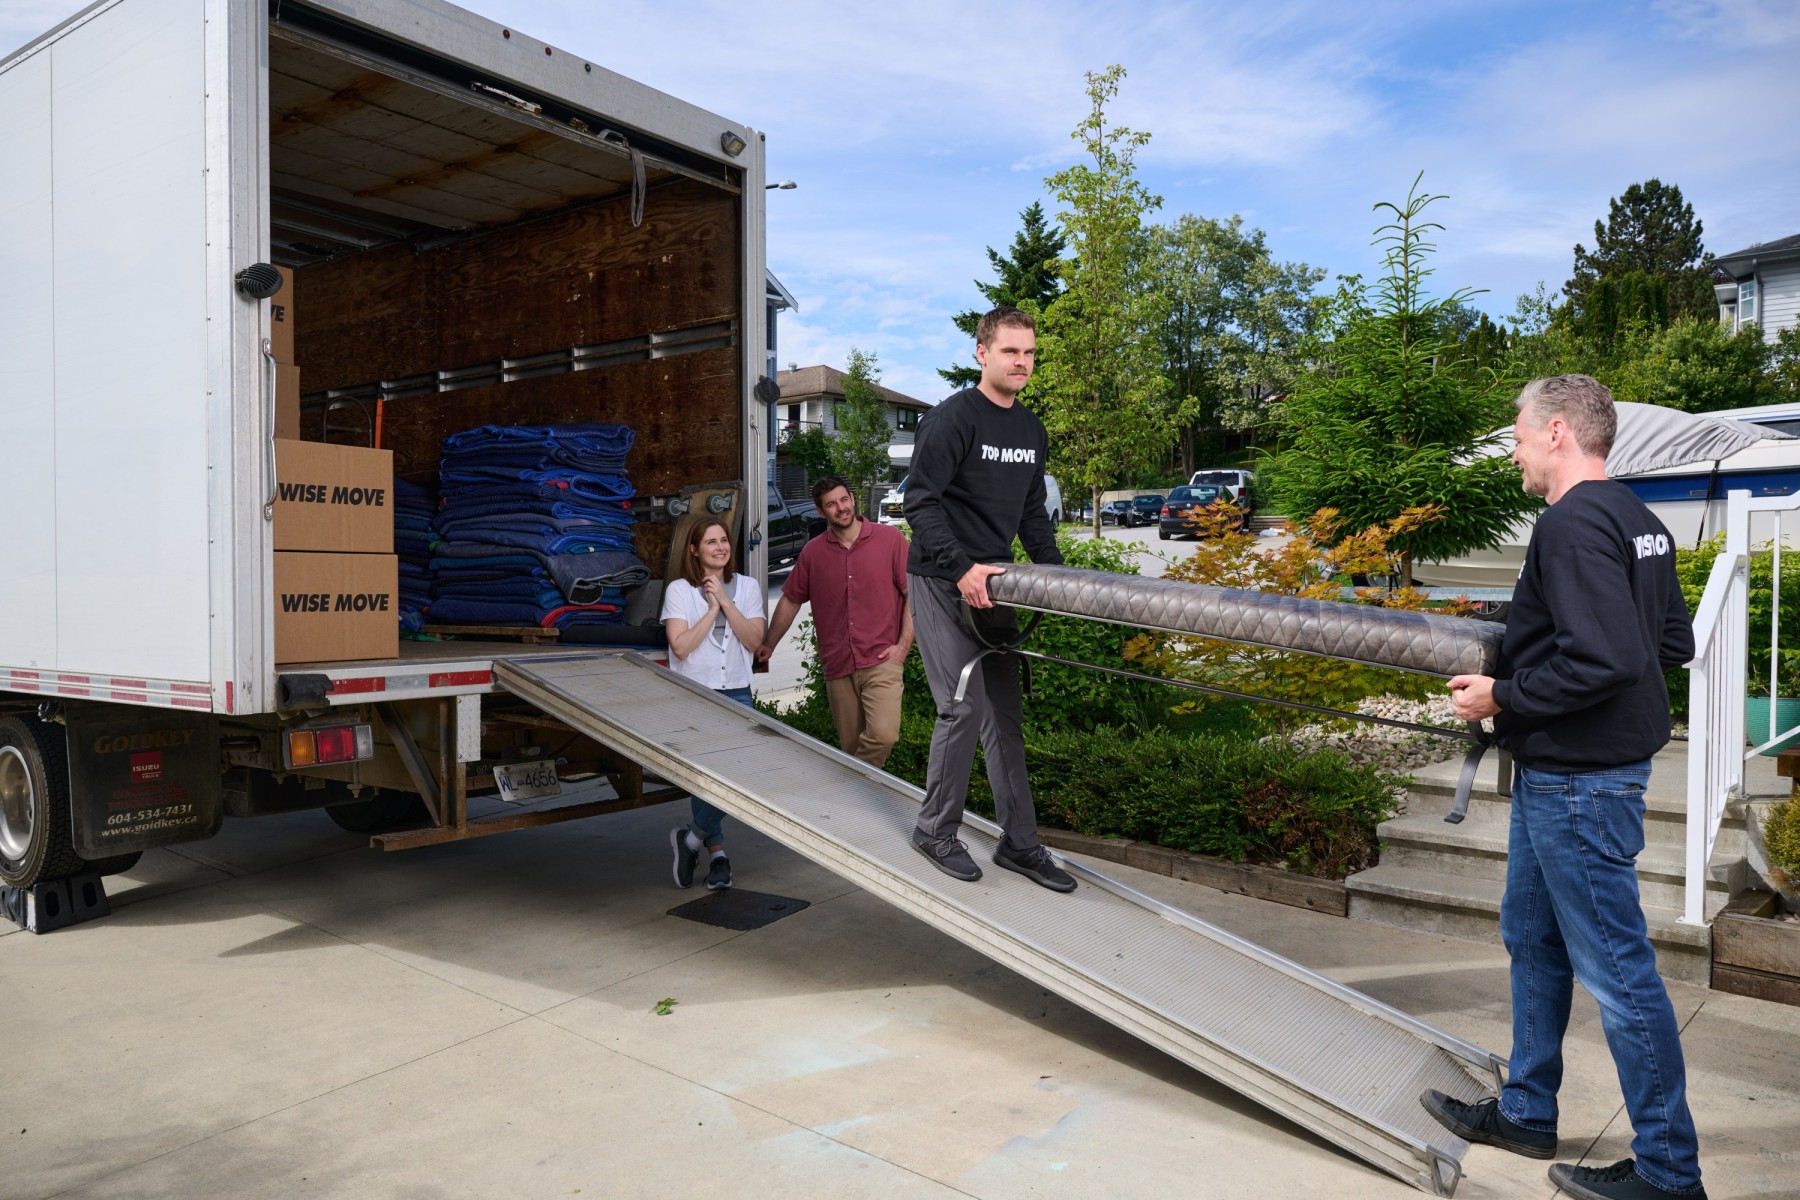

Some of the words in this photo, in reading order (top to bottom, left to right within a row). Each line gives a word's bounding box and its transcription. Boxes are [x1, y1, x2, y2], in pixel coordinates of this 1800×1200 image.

[981, 444, 1000, 461] TOP
[1001, 448, 1036, 464] MOVE
[279, 482, 327, 504] WISE
[331, 486, 385, 507] MOVE
[281, 593, 330, 613] WISE
[334, 593, 389, 612] MOVE
[132, 764, 160, 772] ISUZU
[525, 769, 557, 788] 4656
[107, 804, 193, 825] 604-534-7431
